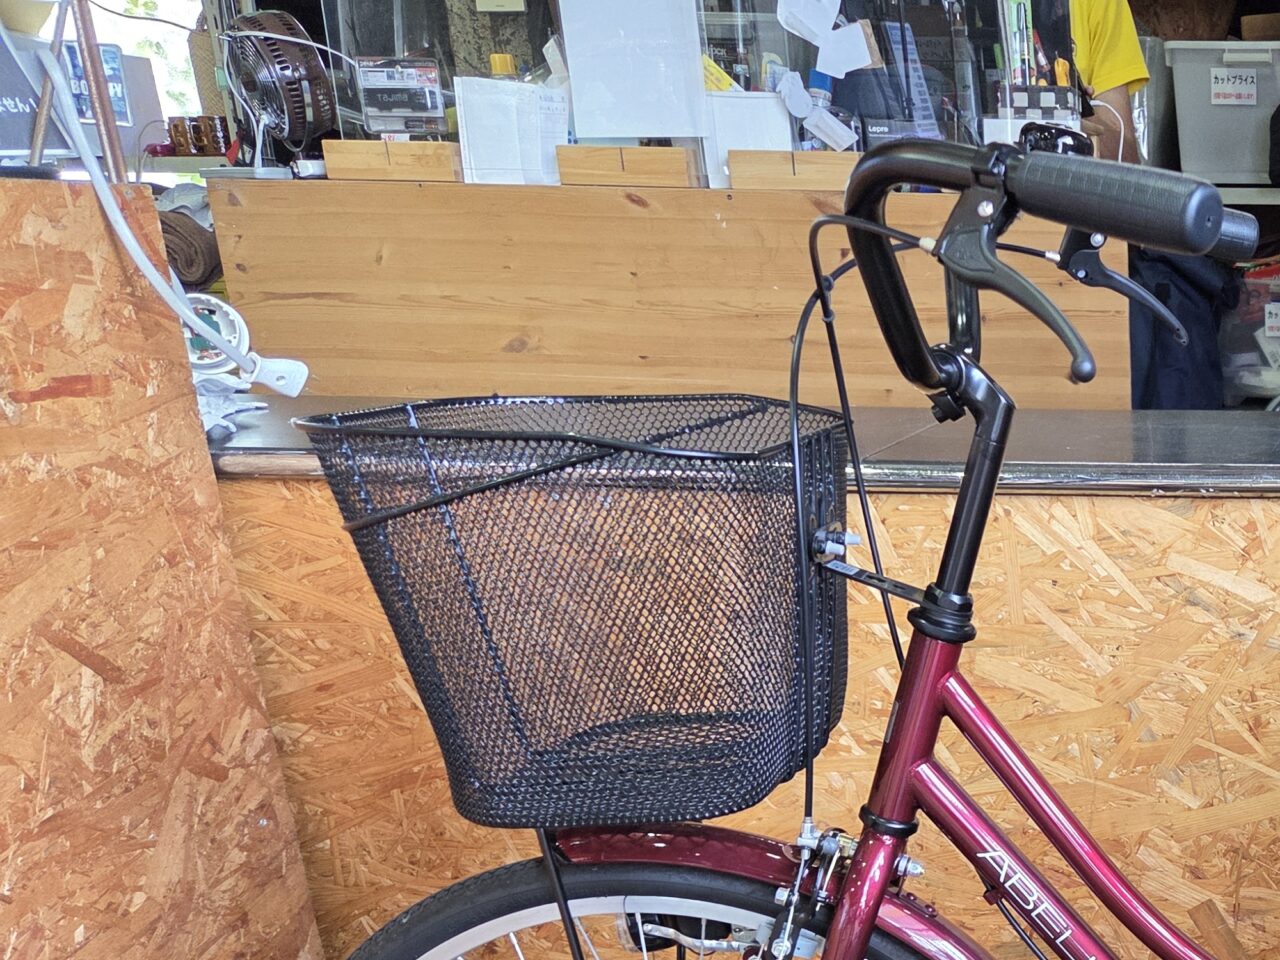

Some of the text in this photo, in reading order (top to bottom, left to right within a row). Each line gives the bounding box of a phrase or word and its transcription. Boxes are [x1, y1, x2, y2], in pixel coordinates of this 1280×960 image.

[1213, 74, 1256, 86] カットプライス
[868, 125, 889, 133] Lepro
